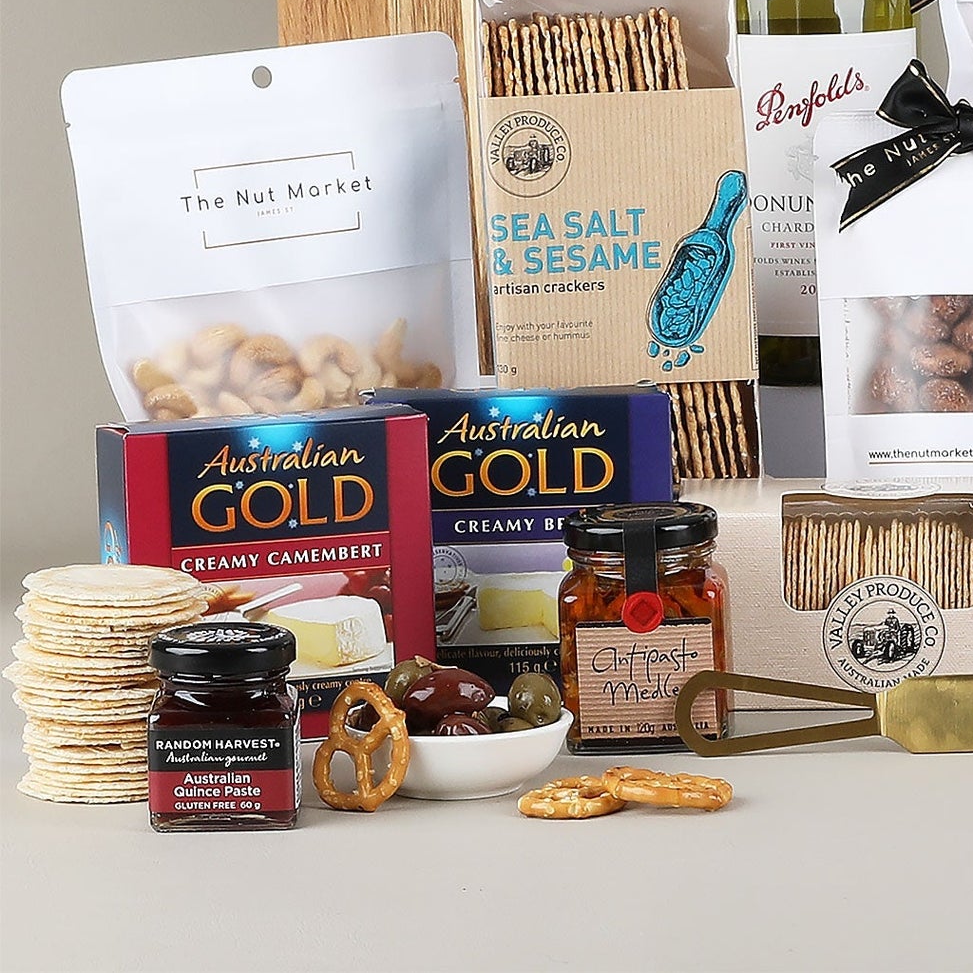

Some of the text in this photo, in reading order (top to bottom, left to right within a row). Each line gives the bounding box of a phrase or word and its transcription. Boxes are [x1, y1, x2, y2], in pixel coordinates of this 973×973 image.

[755, 67, 865, 132] Penfolds
[490, 120, 514, 165] VALLEY
[513, 115, 565, 145] PRODUCE
[180, 175, 373, 214] The Nut Market
[256, 207, 282, 218] JAMES
[490, 207, 646, 243] SEA SALT
[761, 221, 815, 233] CHARD
[770, 241, 797, 249] FIRST
[492, 240, 662, 276] & SESAME
[781, 257, 811, 265] WINES
[493, 279, 606, 296] artisan crackers
[516, 321, 535, 331] with
[536, 322, 556, 332] your
[556, 319, 594, 329] favourite
[510, 333, 541, 343] cheese
[541, 333, 552, 341] or
[552, 331, 592, 341] hummus
[436, 408, 607, 445] Australian
[196, 436, 366, 479] Australian
[430, 446, 615, 498] GOLD
[191, 474, 375, 533] GOLD
[454, 518, 535, 534] CREAMY
[180, 543, 383, 574] CREAMY CAMEMBERT
[829, 588, 864, 650] VALLEY
[864, 582, 936, 624] PRODUCE
[502, 646, 551, 659] deliciously
[509, 661, 531, 674] 115
[837, 657, 901, 688] AUSTRALIAN
[312, 680, 343, 691] creamy
[588, 725, 615, 735] MADE
[620, 724, 631, 734] IN
[155, 739, 213, 750] RANDOM
[165, 750, 269, 768] Australian gourmet
[183, 772, 252, 786] Australian
[173, 785, 262, 799] Quince Paste
[174, 801, 262, 812] GLUTEN FREE 60 g
